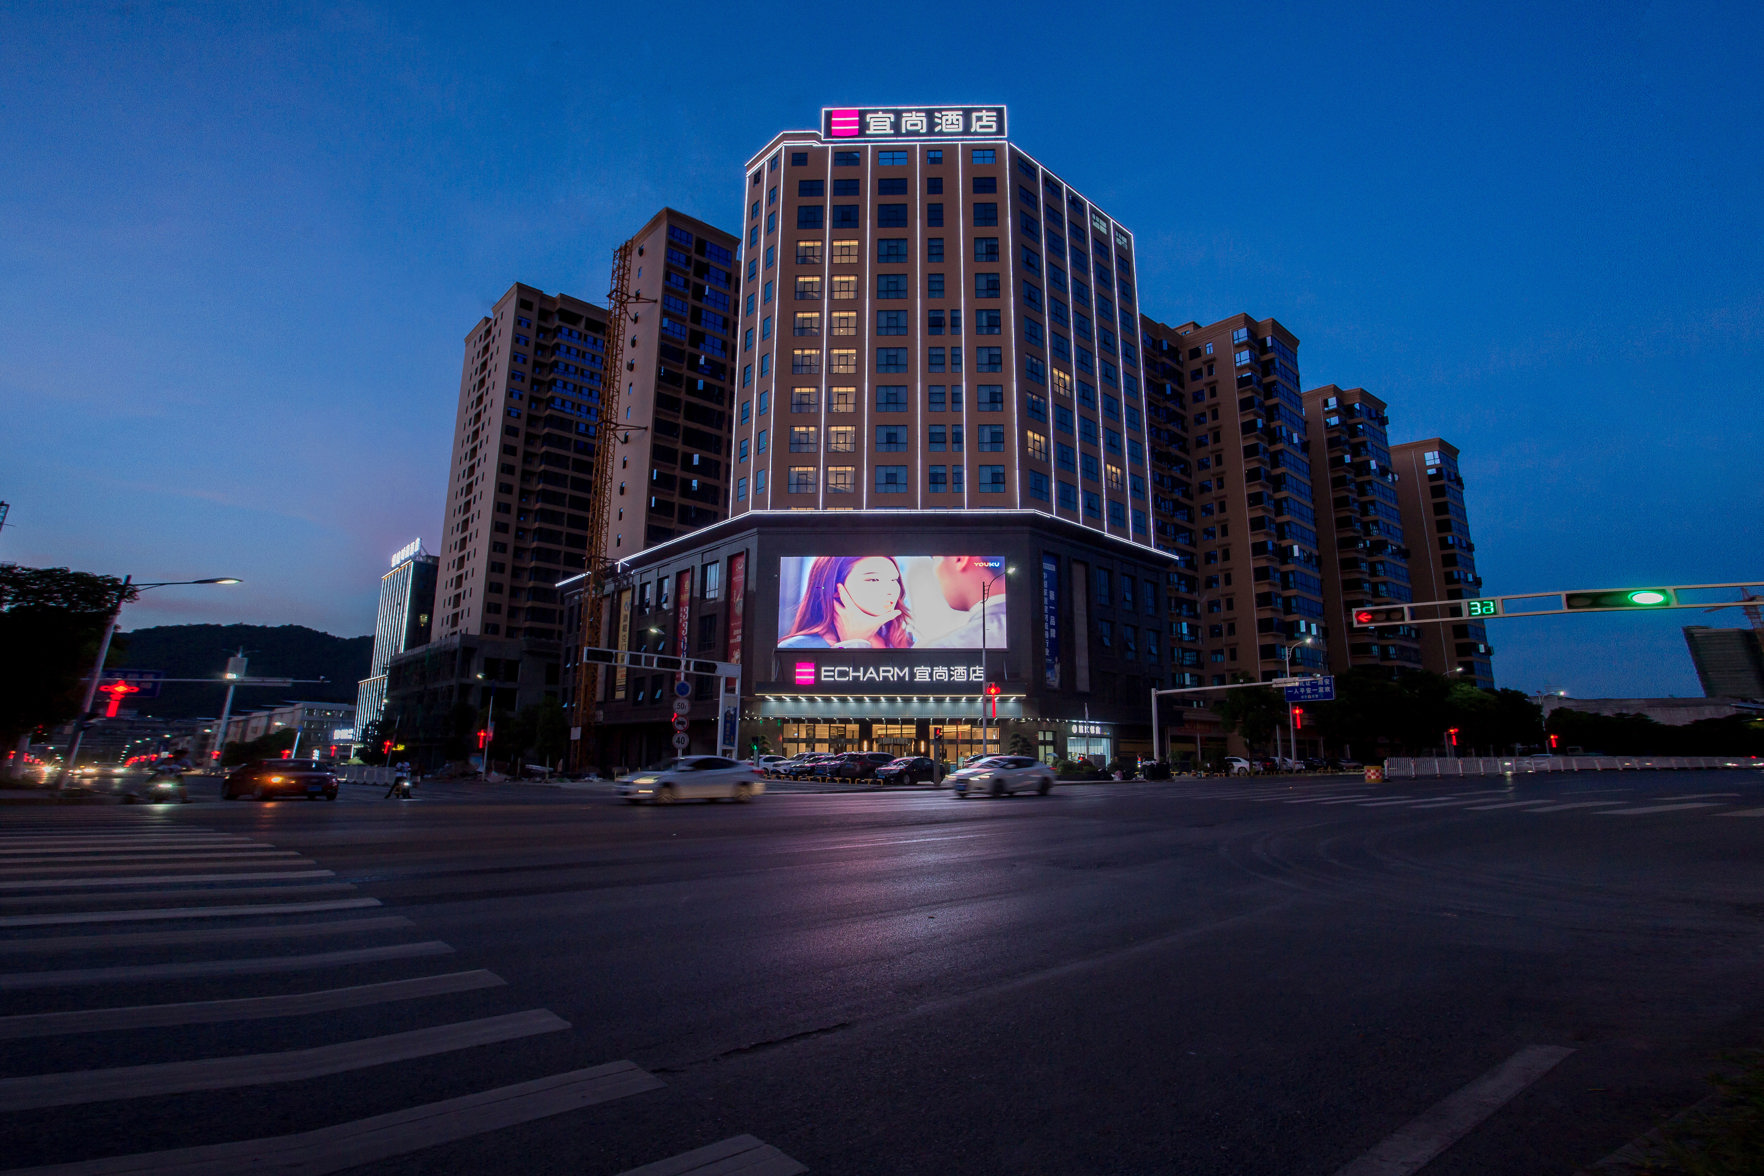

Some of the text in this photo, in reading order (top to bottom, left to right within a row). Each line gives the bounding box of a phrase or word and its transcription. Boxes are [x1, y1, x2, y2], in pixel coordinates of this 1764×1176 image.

[865, 110, 998, 134] 宜尚酒店
[820, 665, 984, 682] ECHARM 宜尚酒店
[676, 736, 685, 745] 40
